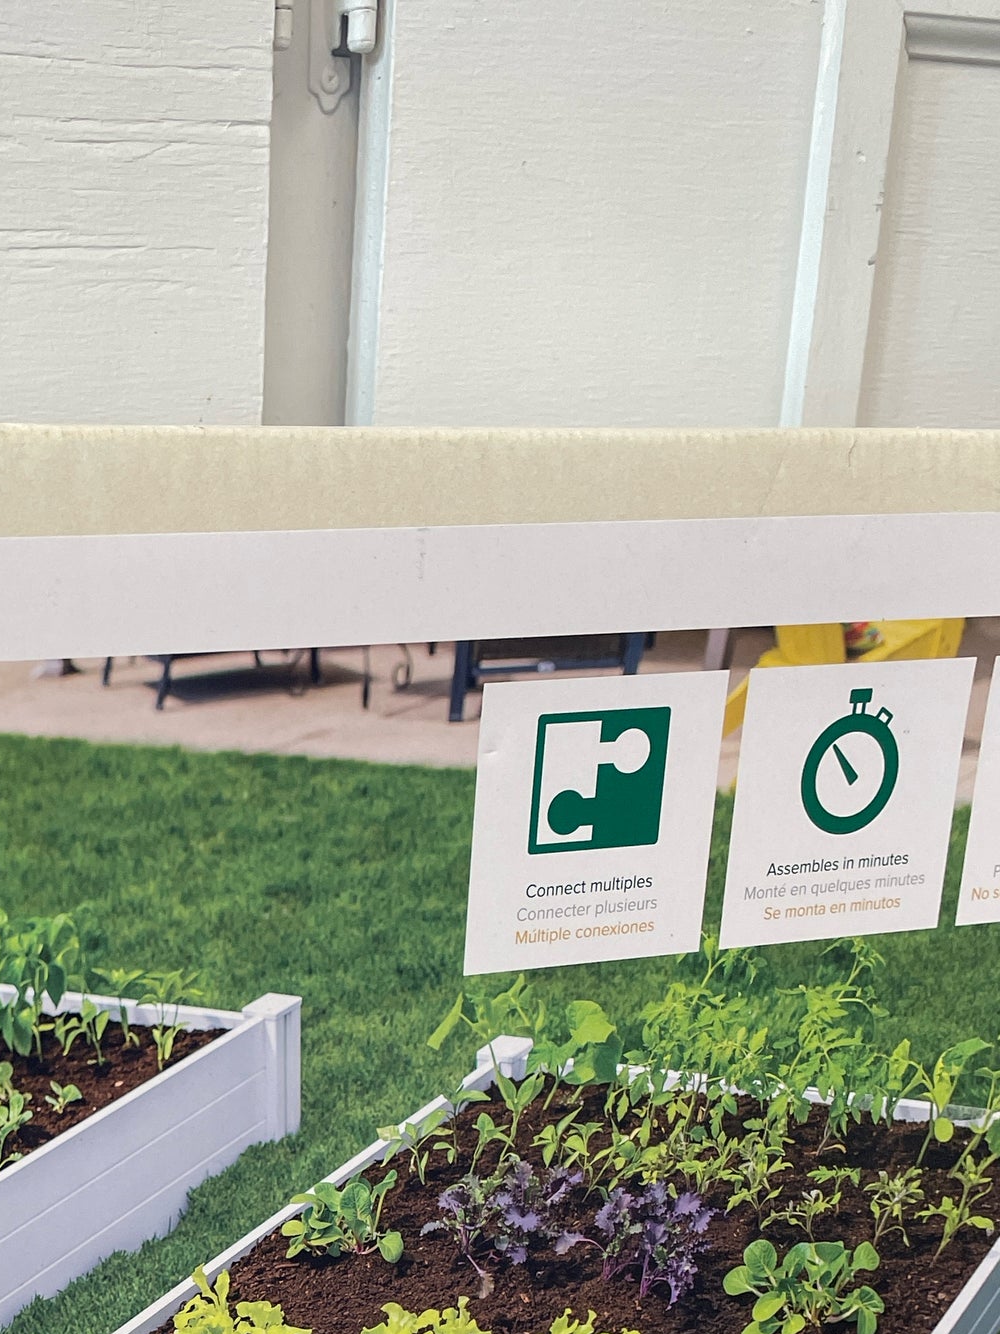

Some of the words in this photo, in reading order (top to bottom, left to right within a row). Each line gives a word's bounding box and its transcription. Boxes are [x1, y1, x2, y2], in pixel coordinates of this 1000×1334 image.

[766, 858, 839, 876] Assembles
[843, 857, 853, 869] in
[858, 853, 909, 868] minutes
[526, 881, 586, 898] Connect
[590, 875, 653, 893] multiples
[744, 883, 786, 900] Monté
[790, 884, 806, 896] en
[811, 878, 871, 896] quelques
[875, 873, 925, 889] minutes
[971, 888, 989, 900] No
[516, 905, 591, 922] Connecter
[595, 898, 657, 917] plusieurs
[763, 906, 781, 920] Se
[785, 903, 826, 918] monta
[830, 902, 846, 914] en
[850, 897, 901, 912] minutos
[515, 927, 571, 944] Múltiple
[576, 920, 655, 939] conexiones
